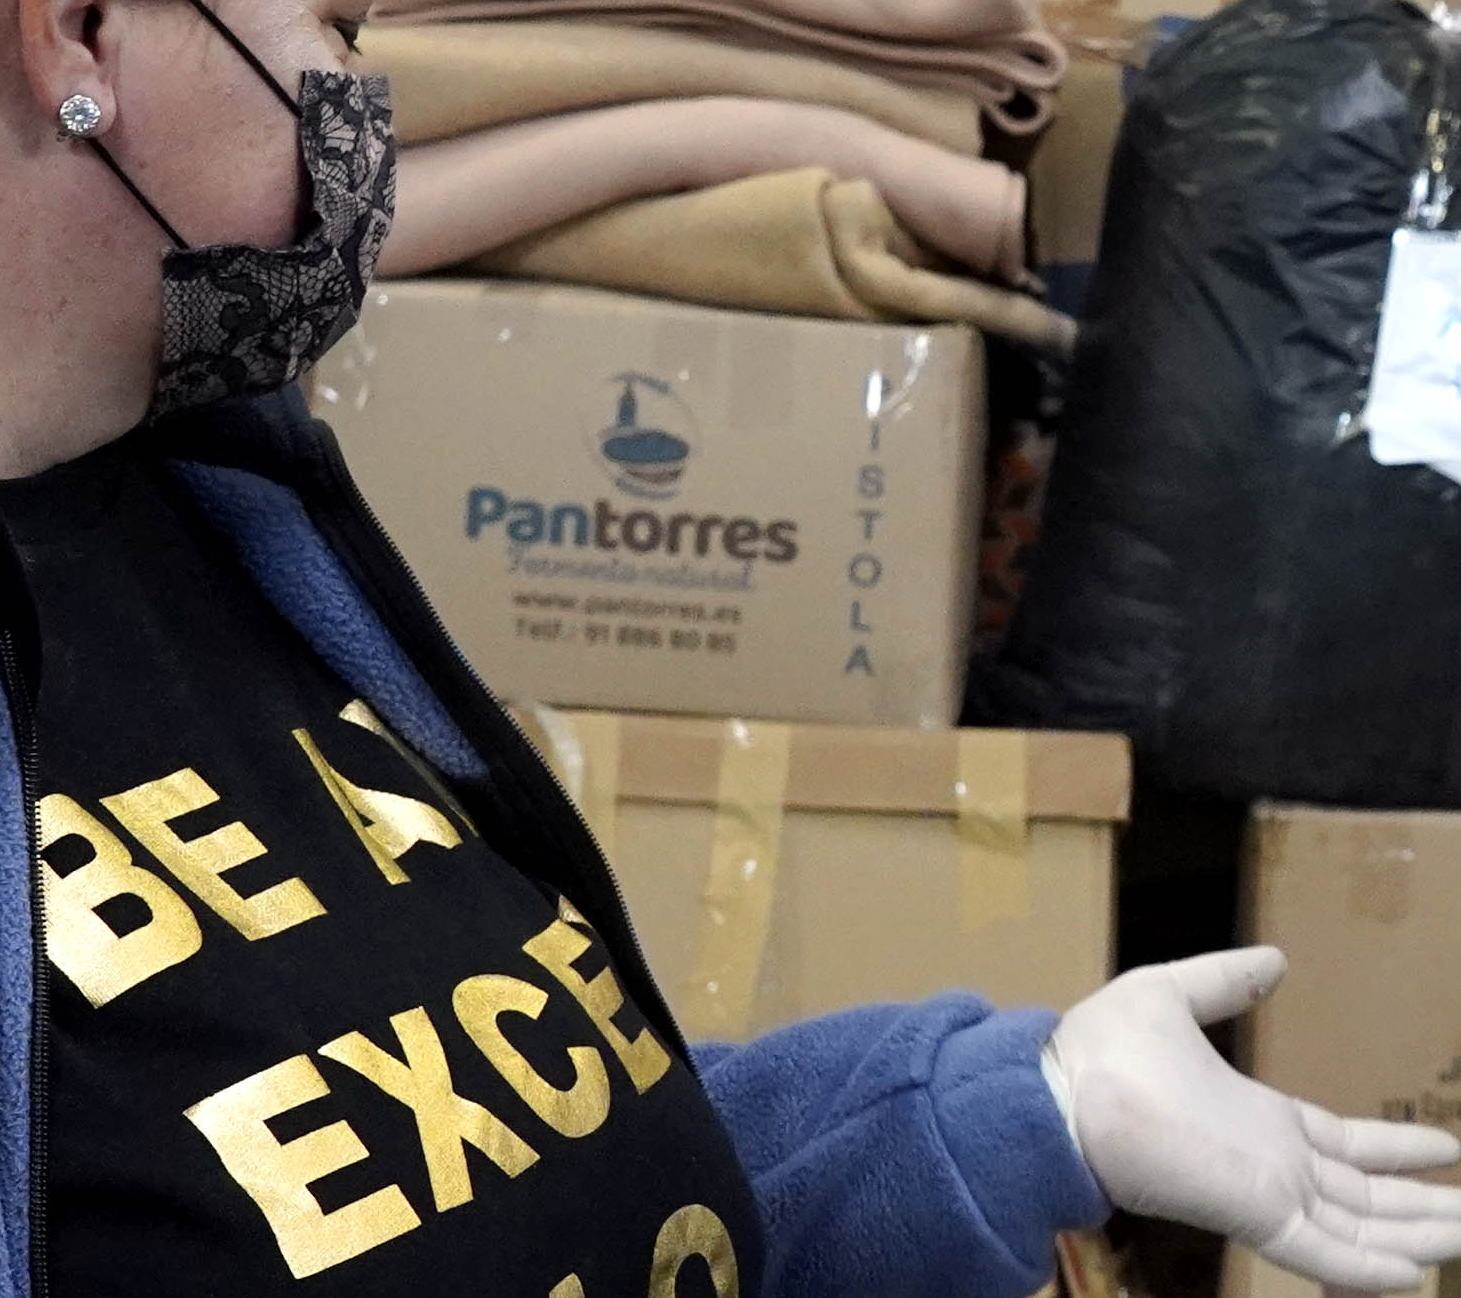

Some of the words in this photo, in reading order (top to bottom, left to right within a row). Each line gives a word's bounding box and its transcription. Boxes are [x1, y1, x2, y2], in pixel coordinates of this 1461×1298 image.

[464, 484, 800, 564] Pantorres
[36, 767, 328, 1010] BE
[291, 698, 480, 886] A
[182, 894, 672, 1280] EXCE
